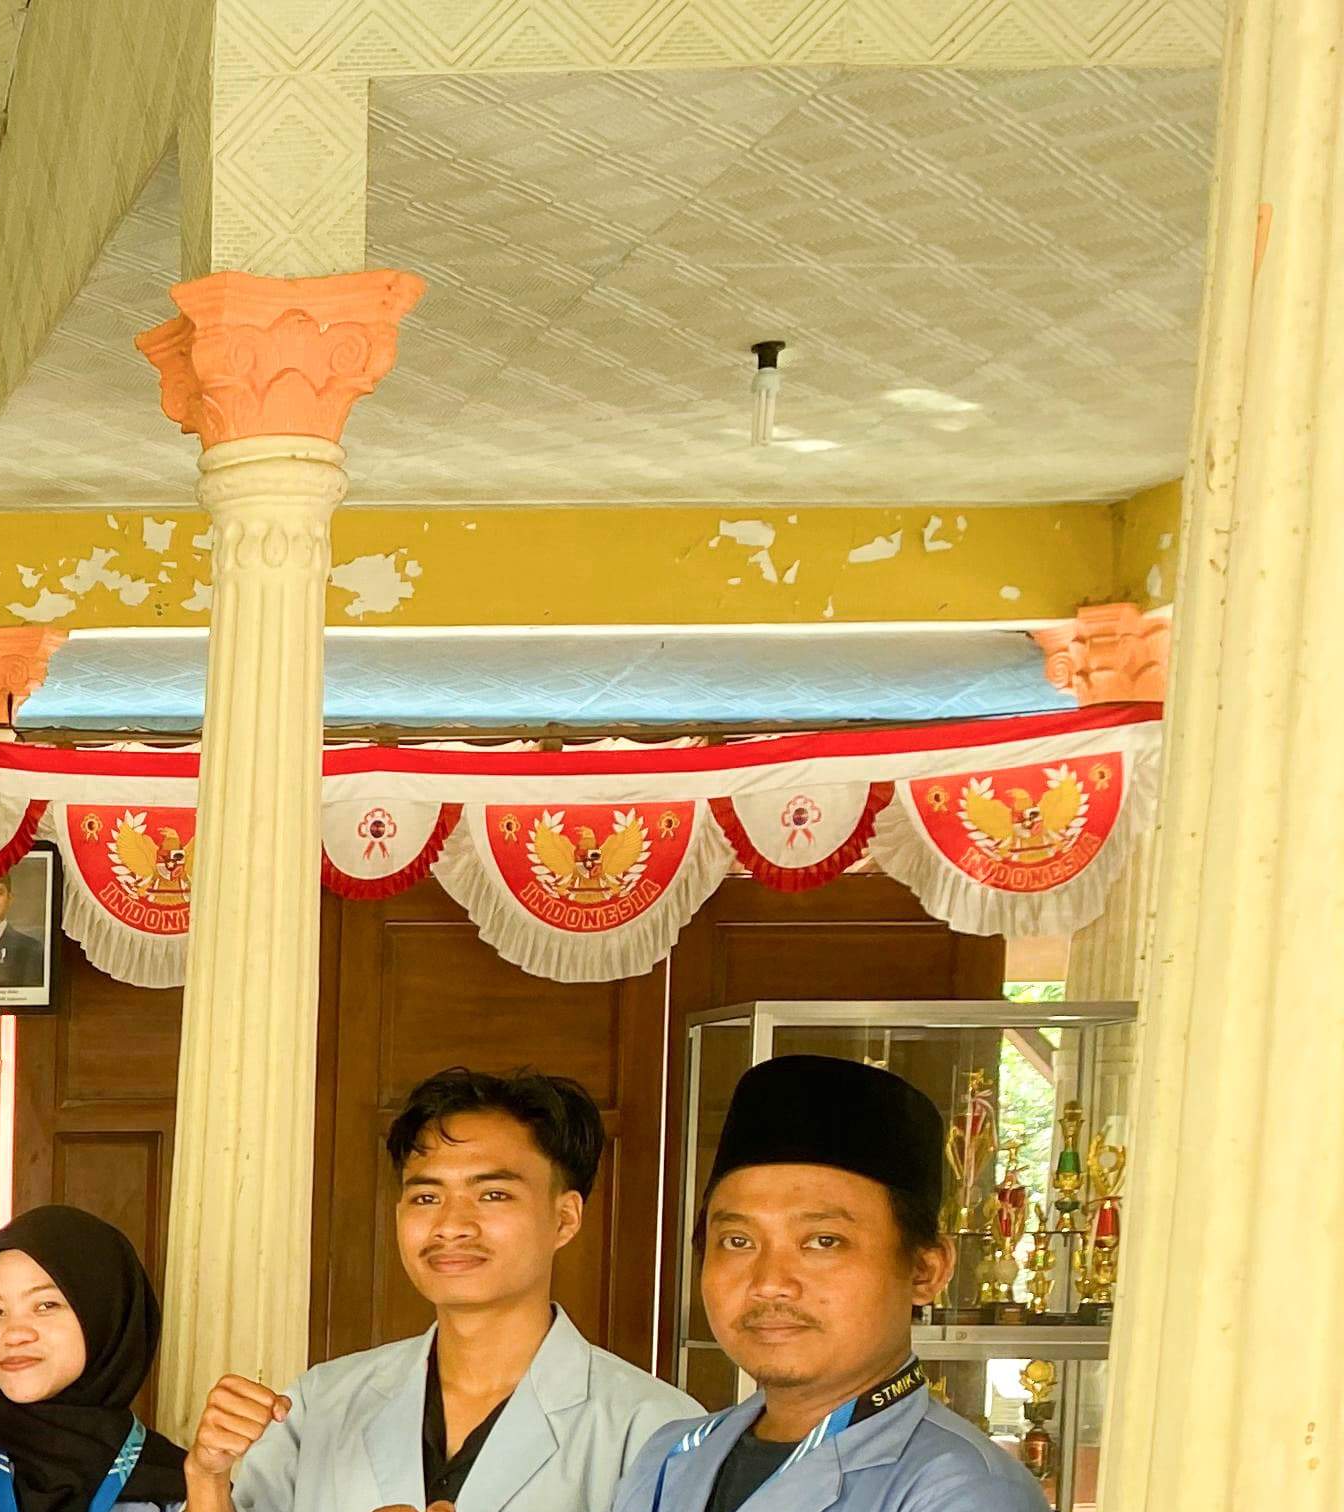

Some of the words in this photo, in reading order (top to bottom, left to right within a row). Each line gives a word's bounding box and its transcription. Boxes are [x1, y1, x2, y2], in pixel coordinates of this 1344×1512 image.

[99, 881, 191, 931] INDON
[520, 879, 662, 928] INDONESIA
[872, 1373, 915, 1407] STMIK
